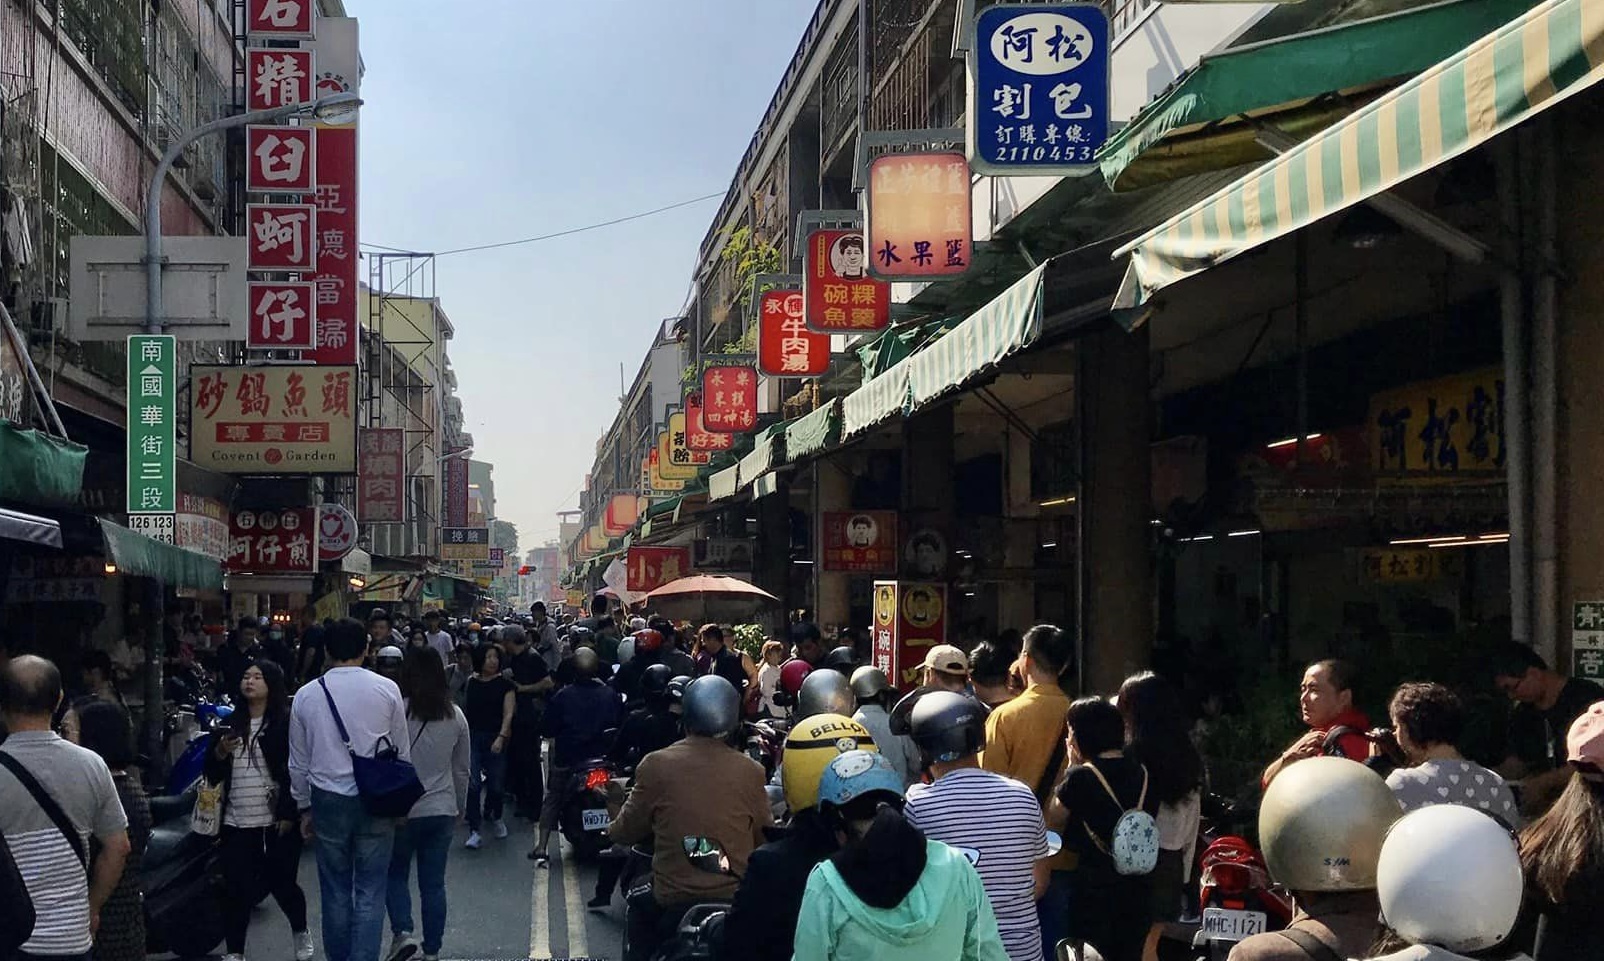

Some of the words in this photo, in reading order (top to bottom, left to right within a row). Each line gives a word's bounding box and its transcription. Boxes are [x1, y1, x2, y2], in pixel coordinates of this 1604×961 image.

[1000, 25, 1085, 63] 阿松
[992, 83, 1093, 119] 割包
[877, 239, 965, 267] 水果籃
[823, 284, 876, 304] 碗粿
[823, 307, 876, 328] 魚羹
[781, 319, 810, 371] 牛肉湯
[195, 371, 350, 419] 砂鍋魚頭
[708, 409, 754, 427] 四神湯
[225, 425, 324, 441] 專賣店
[211, 450, 260, 461] Covent
[286, 449, 336, 461] Garden
[131, 517, 150, 528] 126
[153, 517, 172, 528] 123
[1204, 917, 1262, 935] MHC-1121
